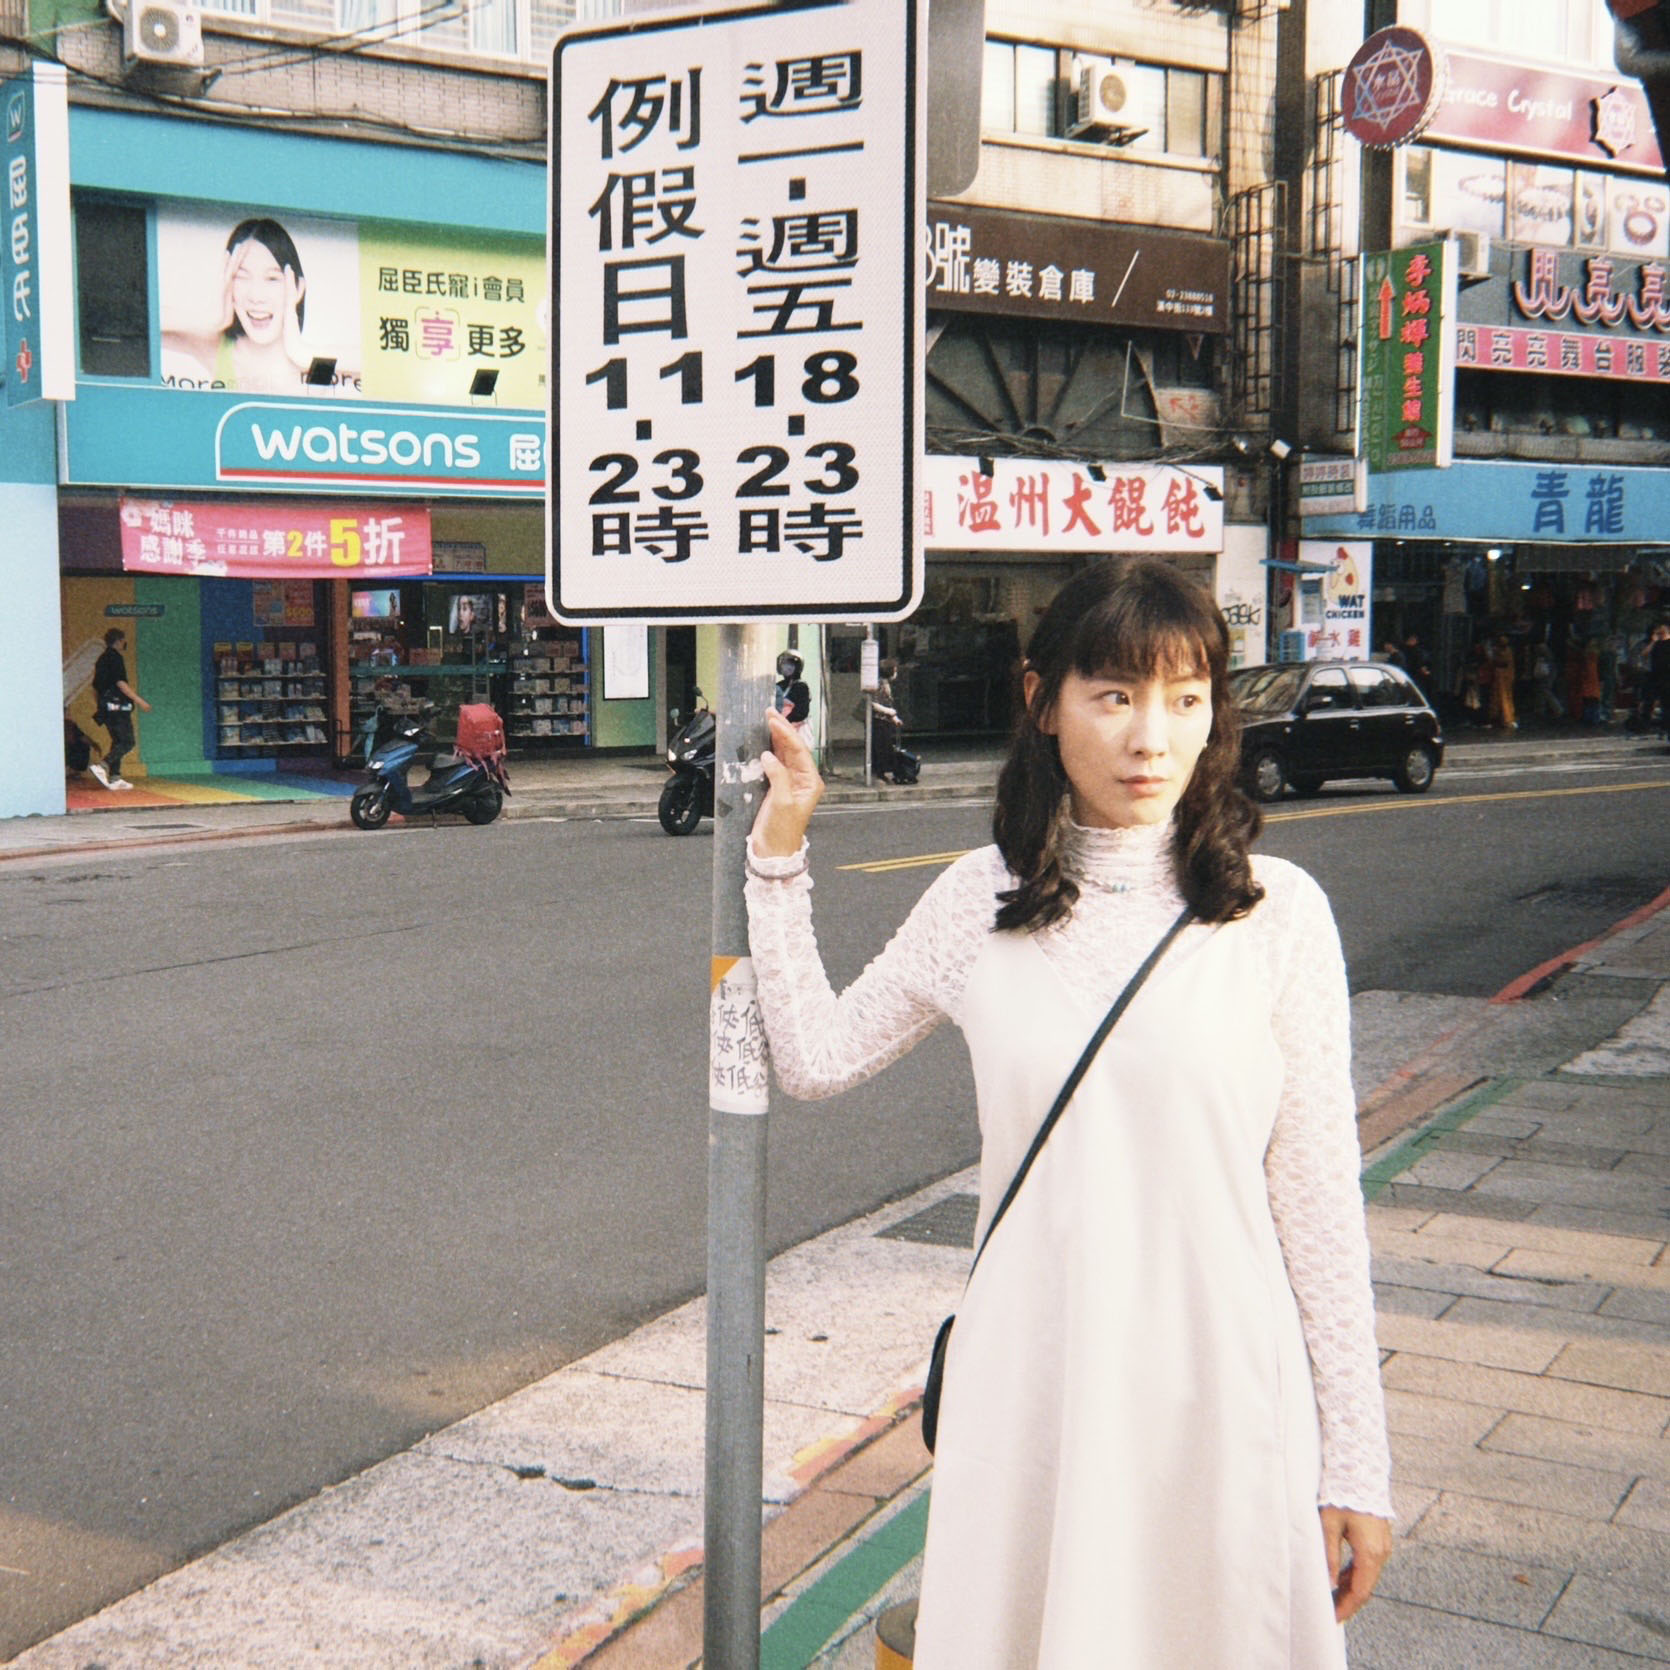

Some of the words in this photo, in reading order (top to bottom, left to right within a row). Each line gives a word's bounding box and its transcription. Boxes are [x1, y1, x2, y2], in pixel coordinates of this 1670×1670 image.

[1507, 88, 1572, 121] Crystal
[379, 311, 526, 358] 獨享更多
[251, 423, 480, 469] watsons
[509, 433, 545, 471] 屈
[1531, 471, 1624, 534] 青龍
[1325, 610, 1364, 619] CHICKEN
[1339, 595, 1365, 608] WAT
